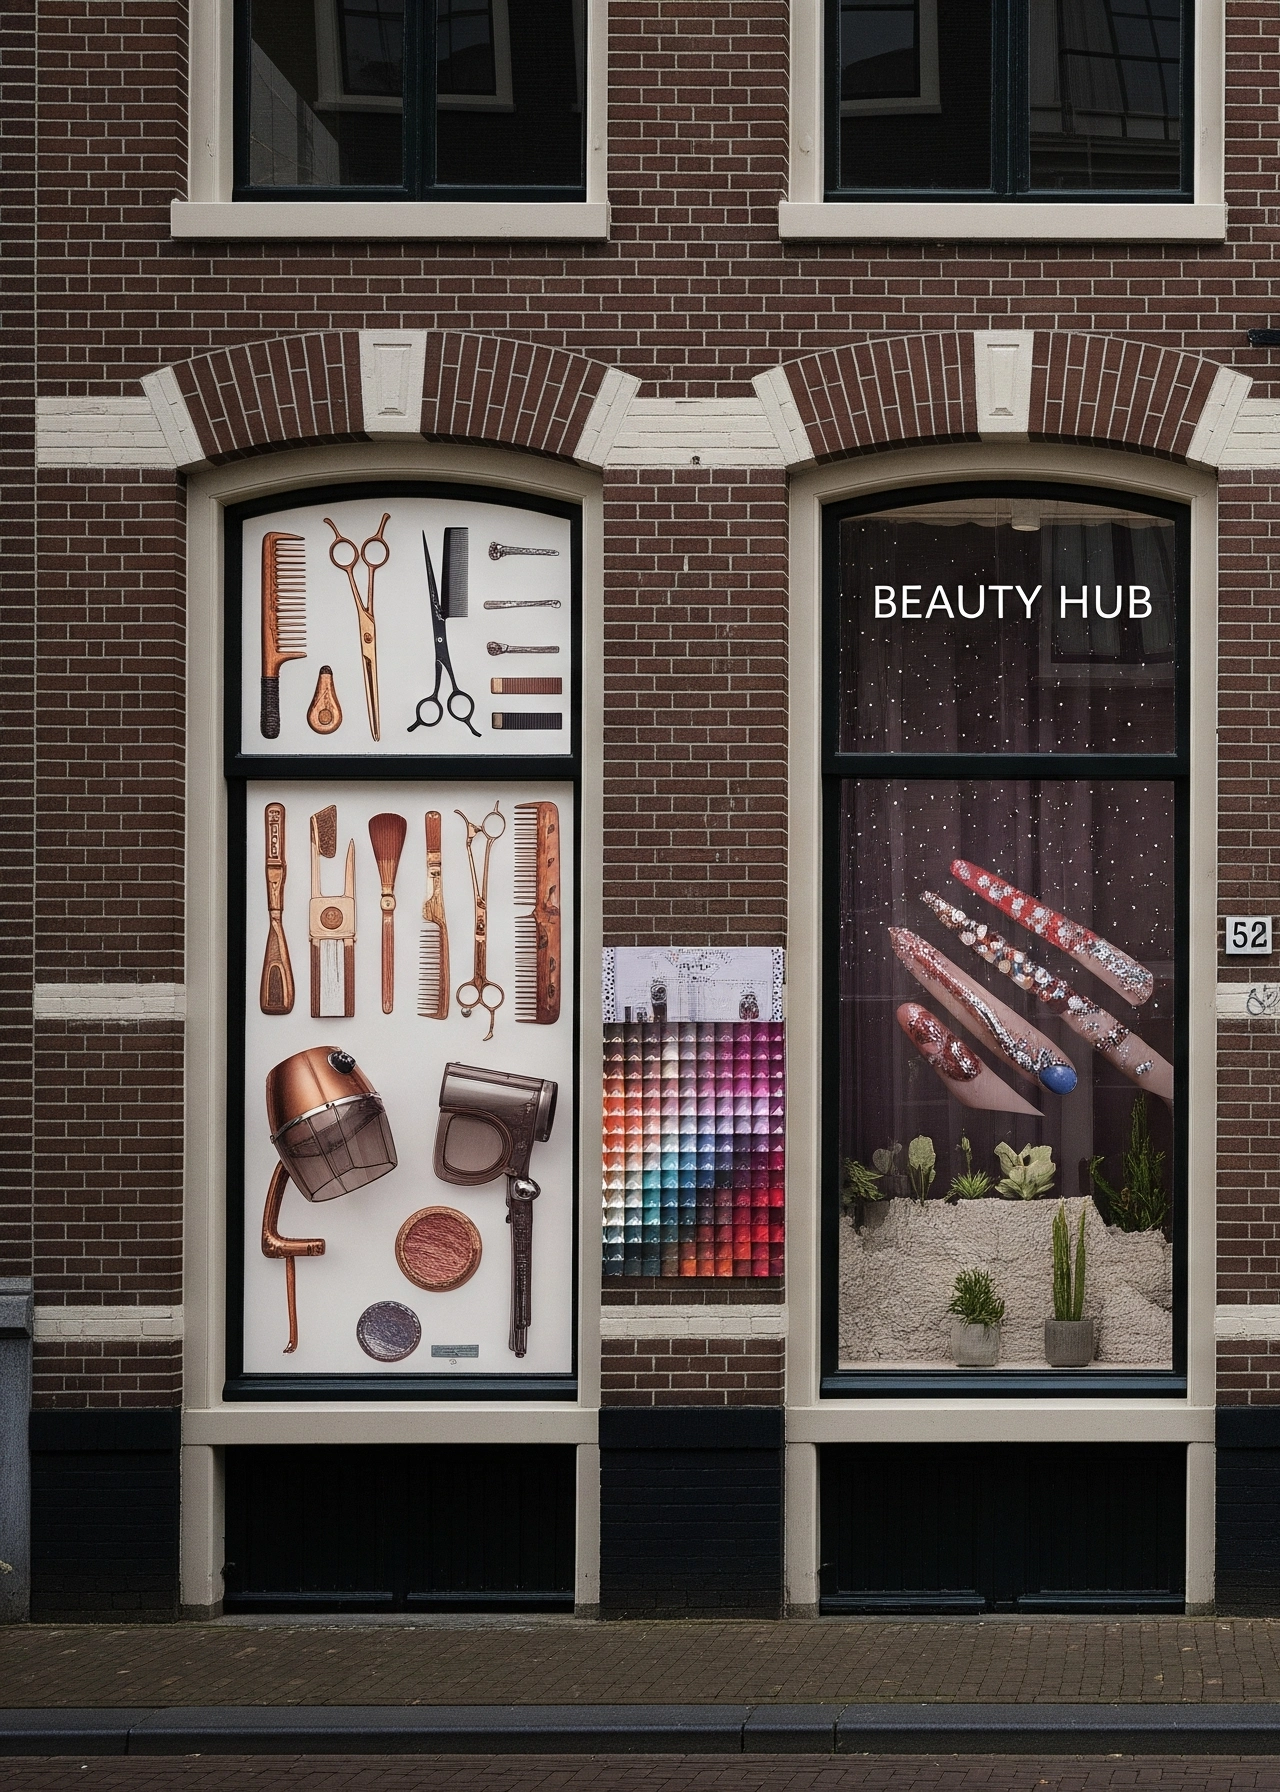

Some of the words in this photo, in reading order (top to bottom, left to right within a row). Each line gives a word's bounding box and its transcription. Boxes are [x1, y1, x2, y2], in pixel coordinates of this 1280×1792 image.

[874, 584, 1043, 619] BEAUTY
[1060, 584, 1153, 619] HUB
[1232, 921, 1268, 949] 52
